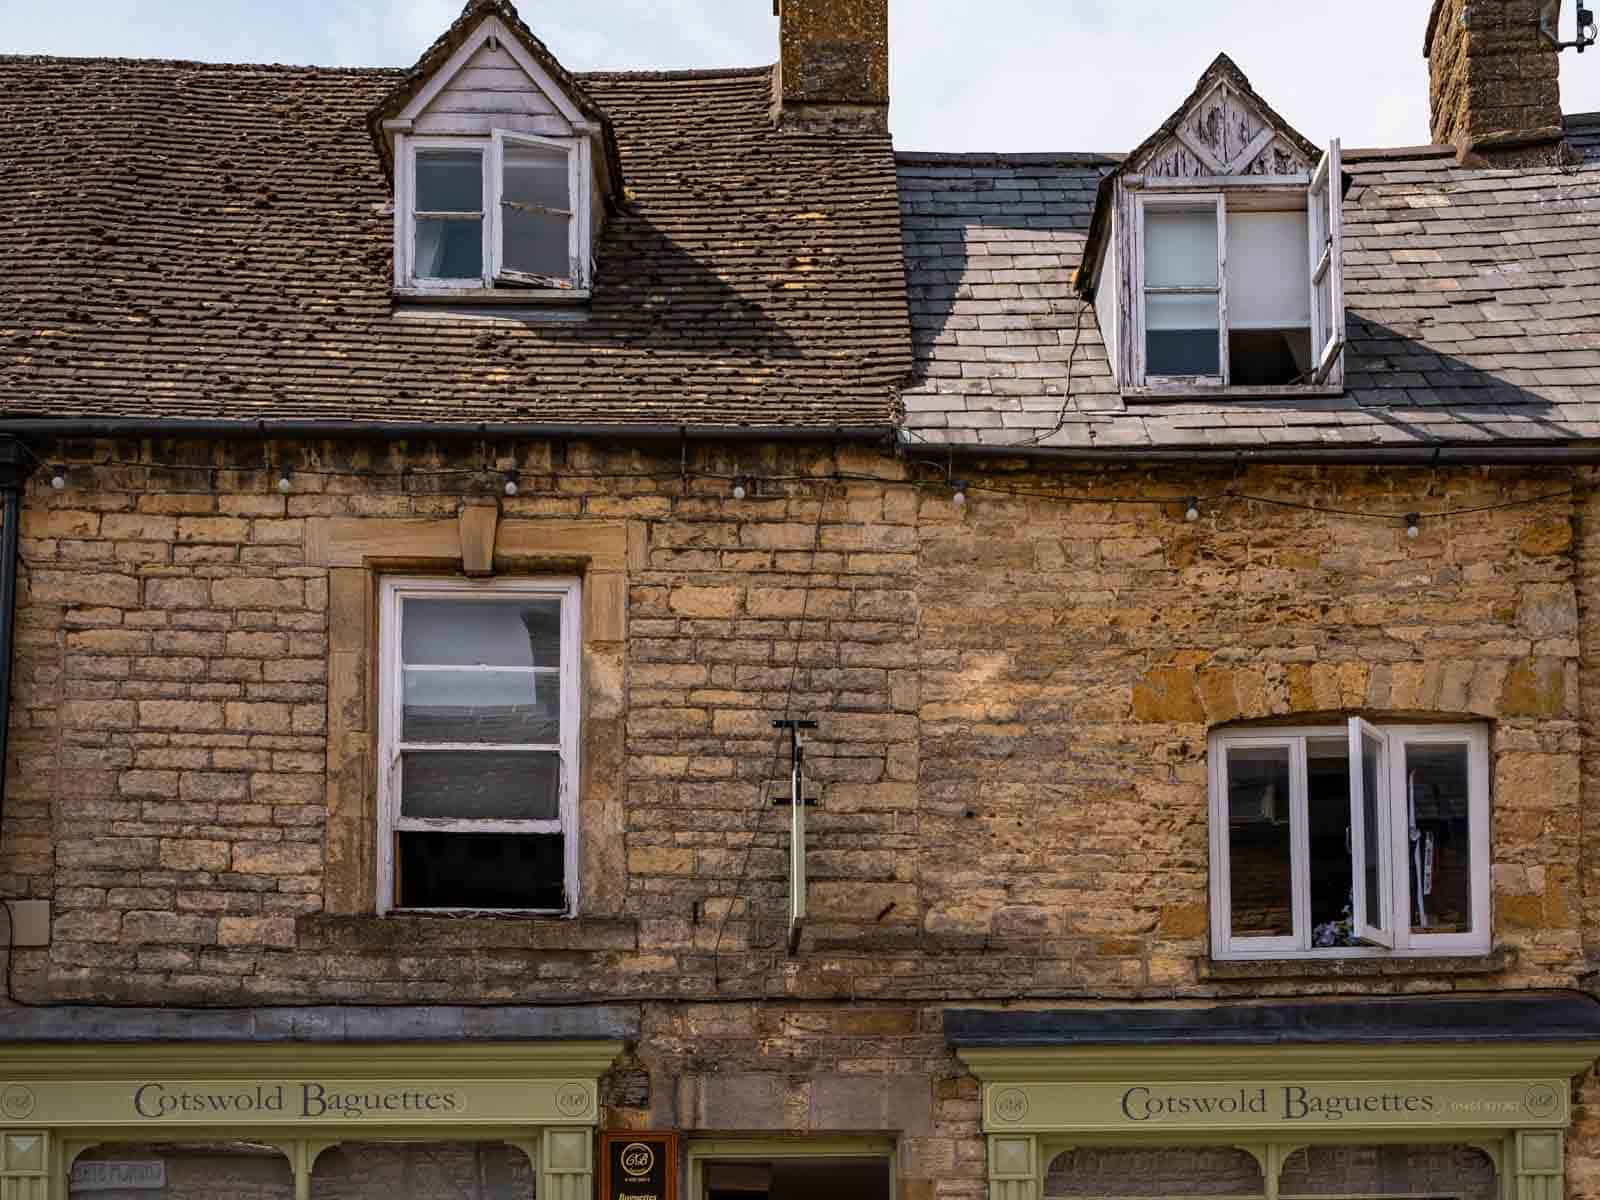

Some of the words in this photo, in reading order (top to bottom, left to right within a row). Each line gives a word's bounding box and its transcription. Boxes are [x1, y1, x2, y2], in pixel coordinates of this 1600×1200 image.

[134, 1081, 284, 1118] Cotswold
[298, 1082, 456, 1117] Baguettes
[1121, 1086, 1268, 1121] Cotswold
[1281, 1086, 1434, 1120] Baguettes
